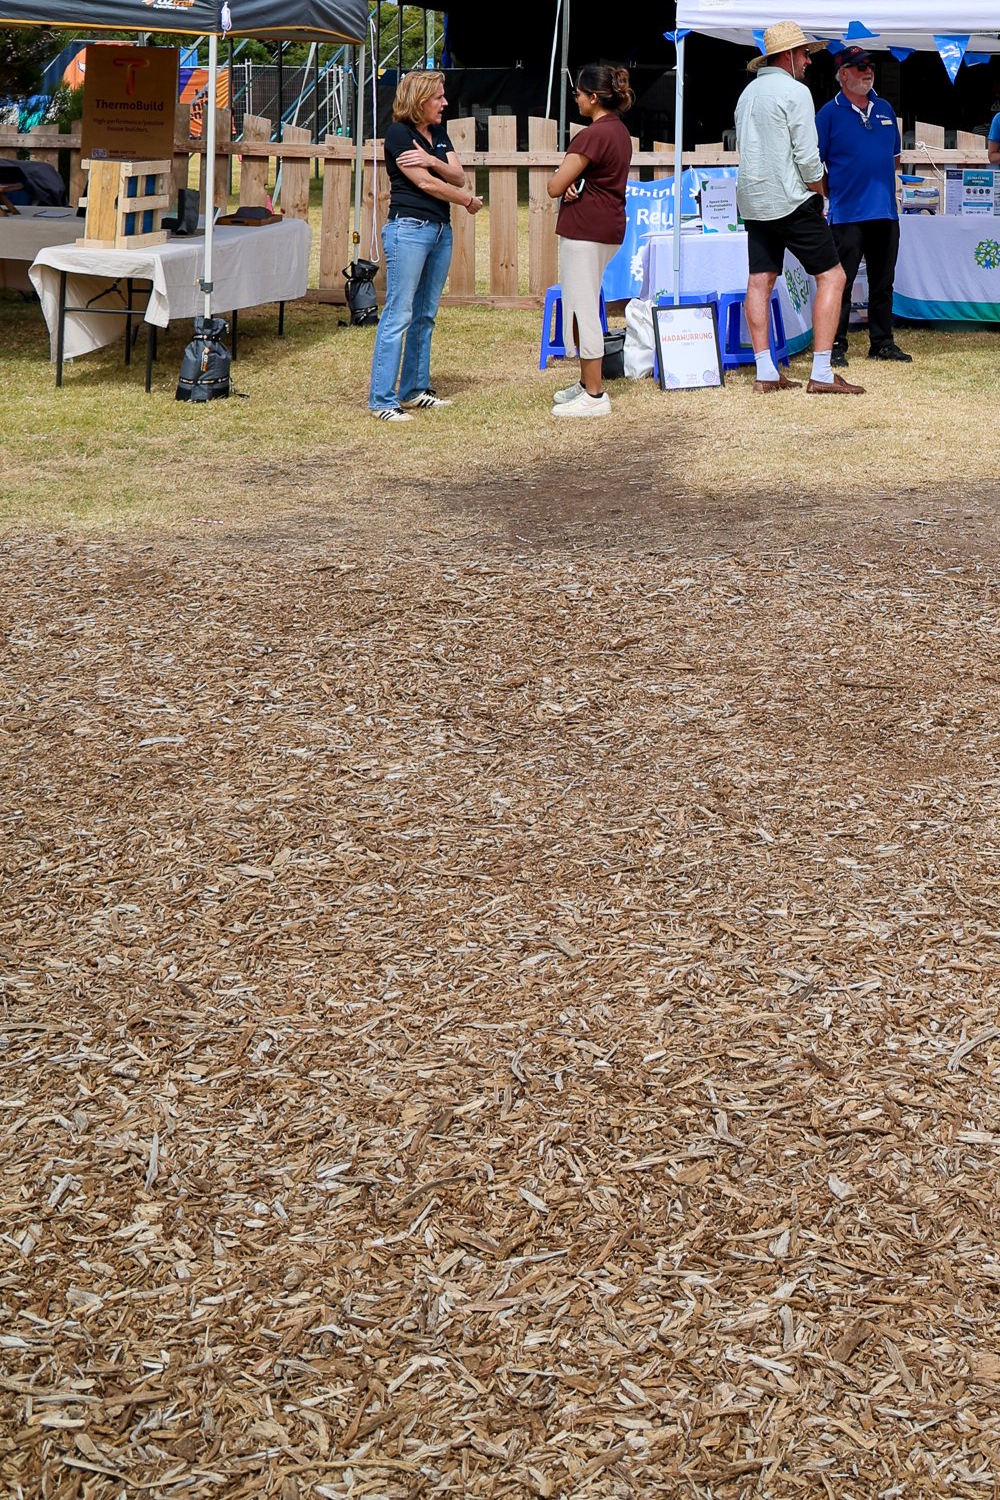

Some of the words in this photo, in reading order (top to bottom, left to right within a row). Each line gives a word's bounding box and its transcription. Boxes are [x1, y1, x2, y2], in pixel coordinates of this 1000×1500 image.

[96, 99, 164, 111] ThermoBuild
[625, 182, 675, 198] ethin
[637, 208, 674, 226] Reu
